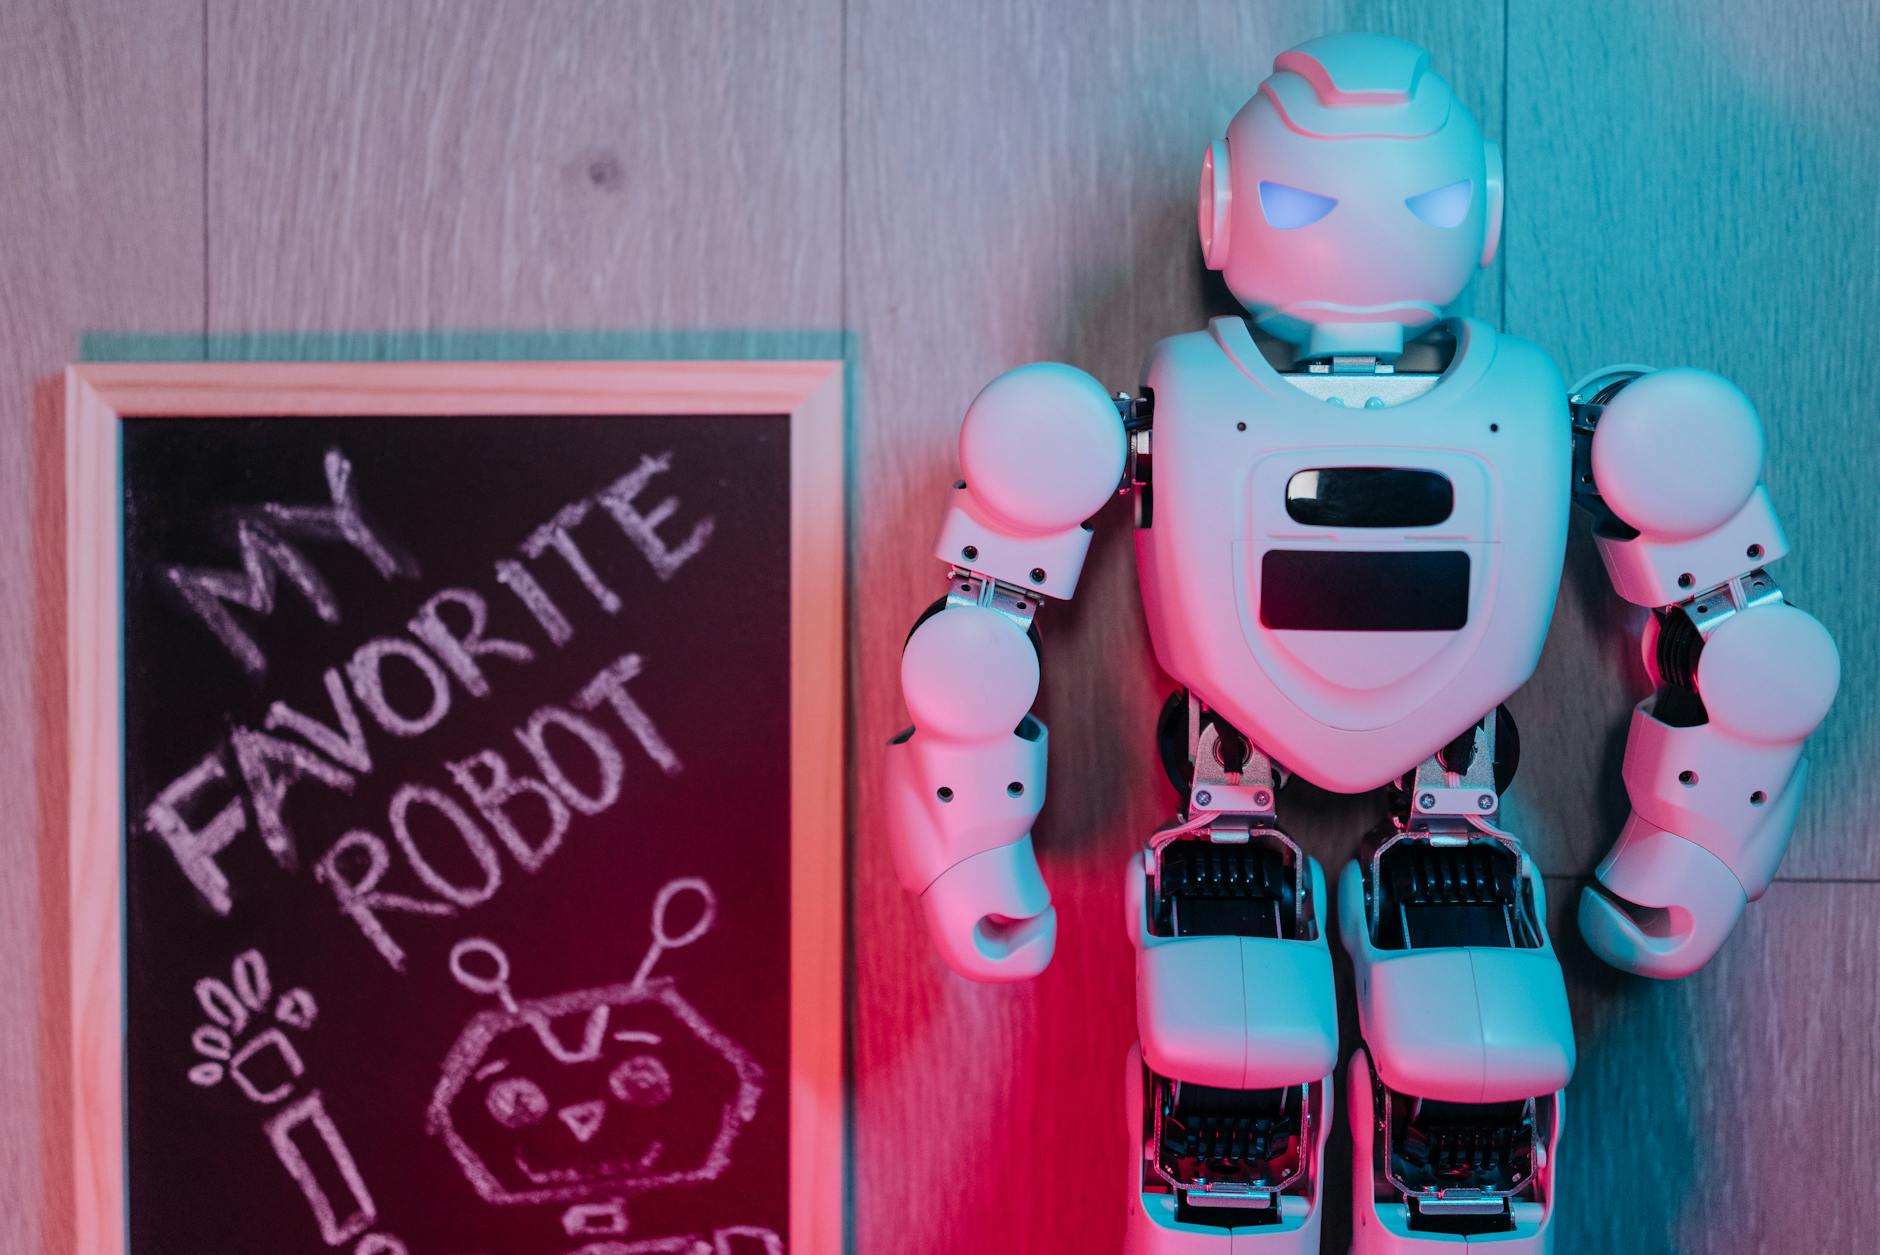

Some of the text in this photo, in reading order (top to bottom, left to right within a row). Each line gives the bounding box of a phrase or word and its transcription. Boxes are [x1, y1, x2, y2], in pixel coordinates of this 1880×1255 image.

[145, 452, 715, 916] FAVORITE
[165, 446, 404, 673] MY
[314, 652, 683, 971] ROBOT
